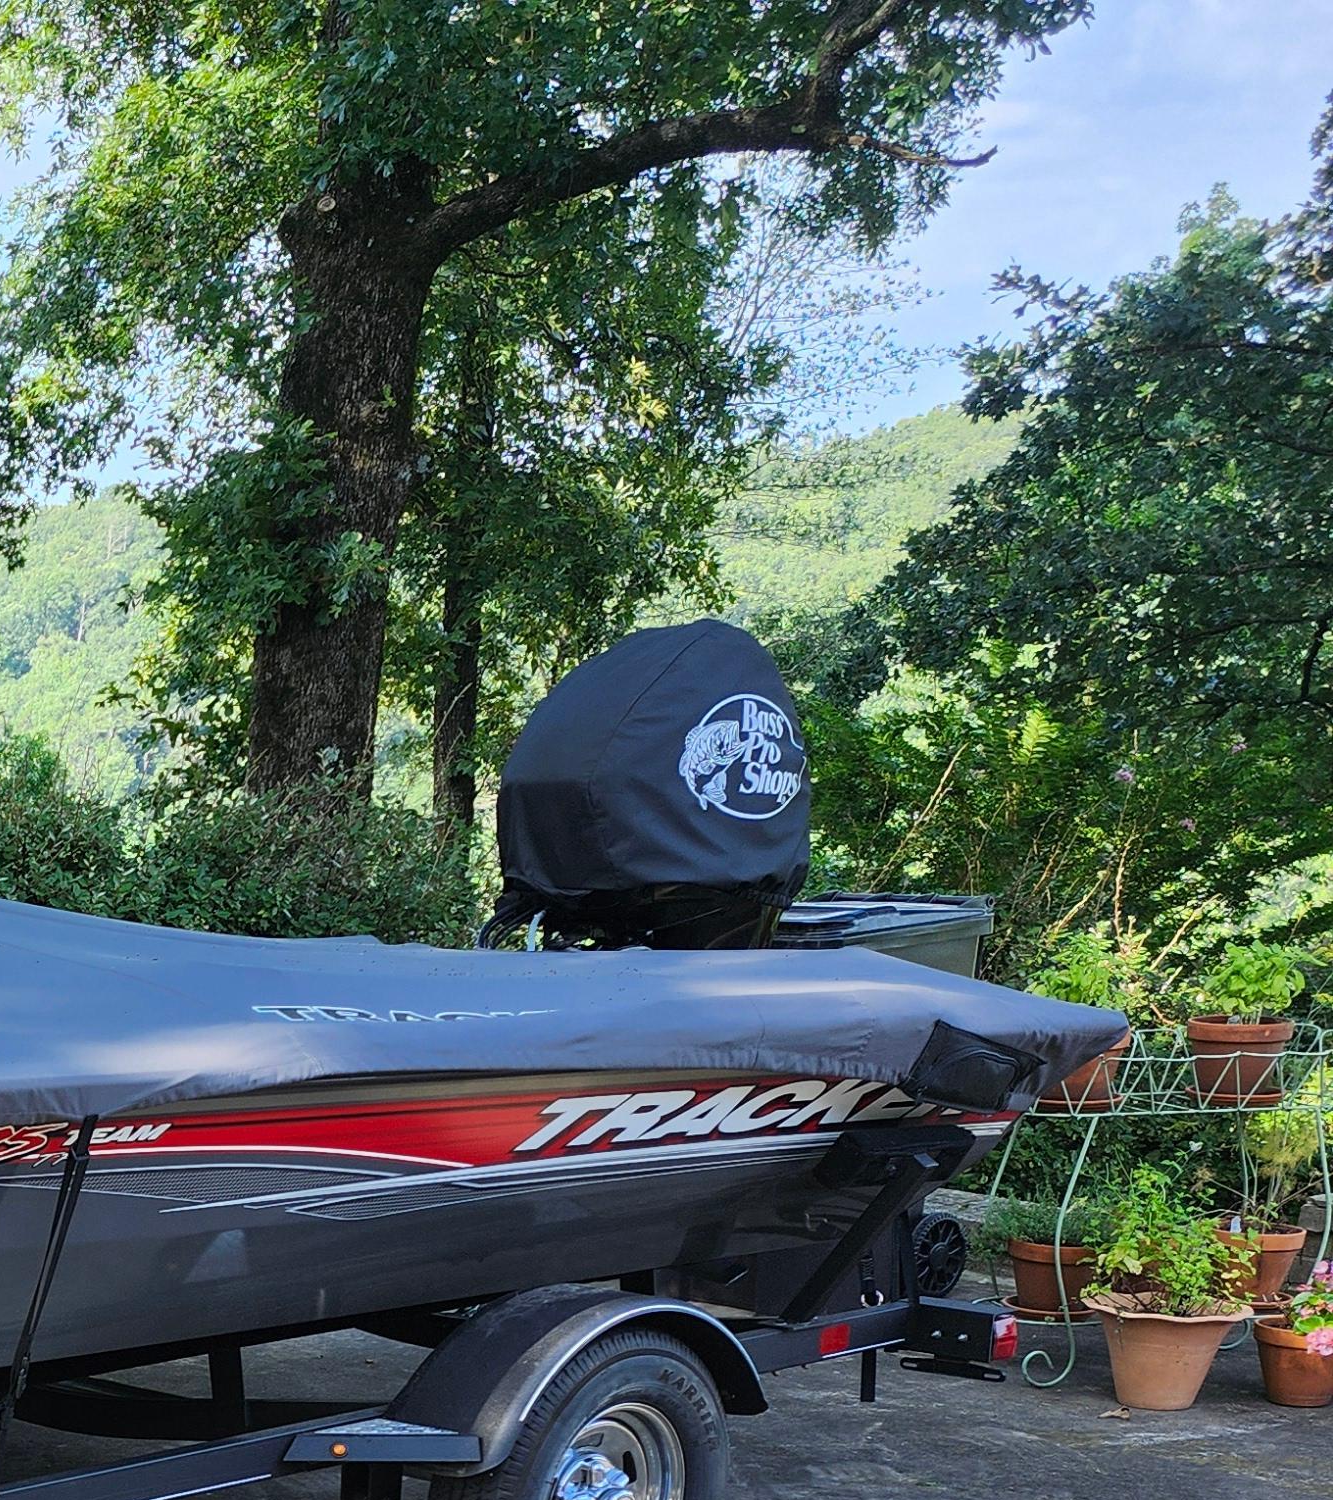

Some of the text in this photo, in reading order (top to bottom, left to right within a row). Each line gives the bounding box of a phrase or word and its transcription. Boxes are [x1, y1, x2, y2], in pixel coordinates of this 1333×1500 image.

[741, 700, 785, 739] Bass
[741, 731, 782, 765] Pro
[738, 762, 800, 804] Shops
